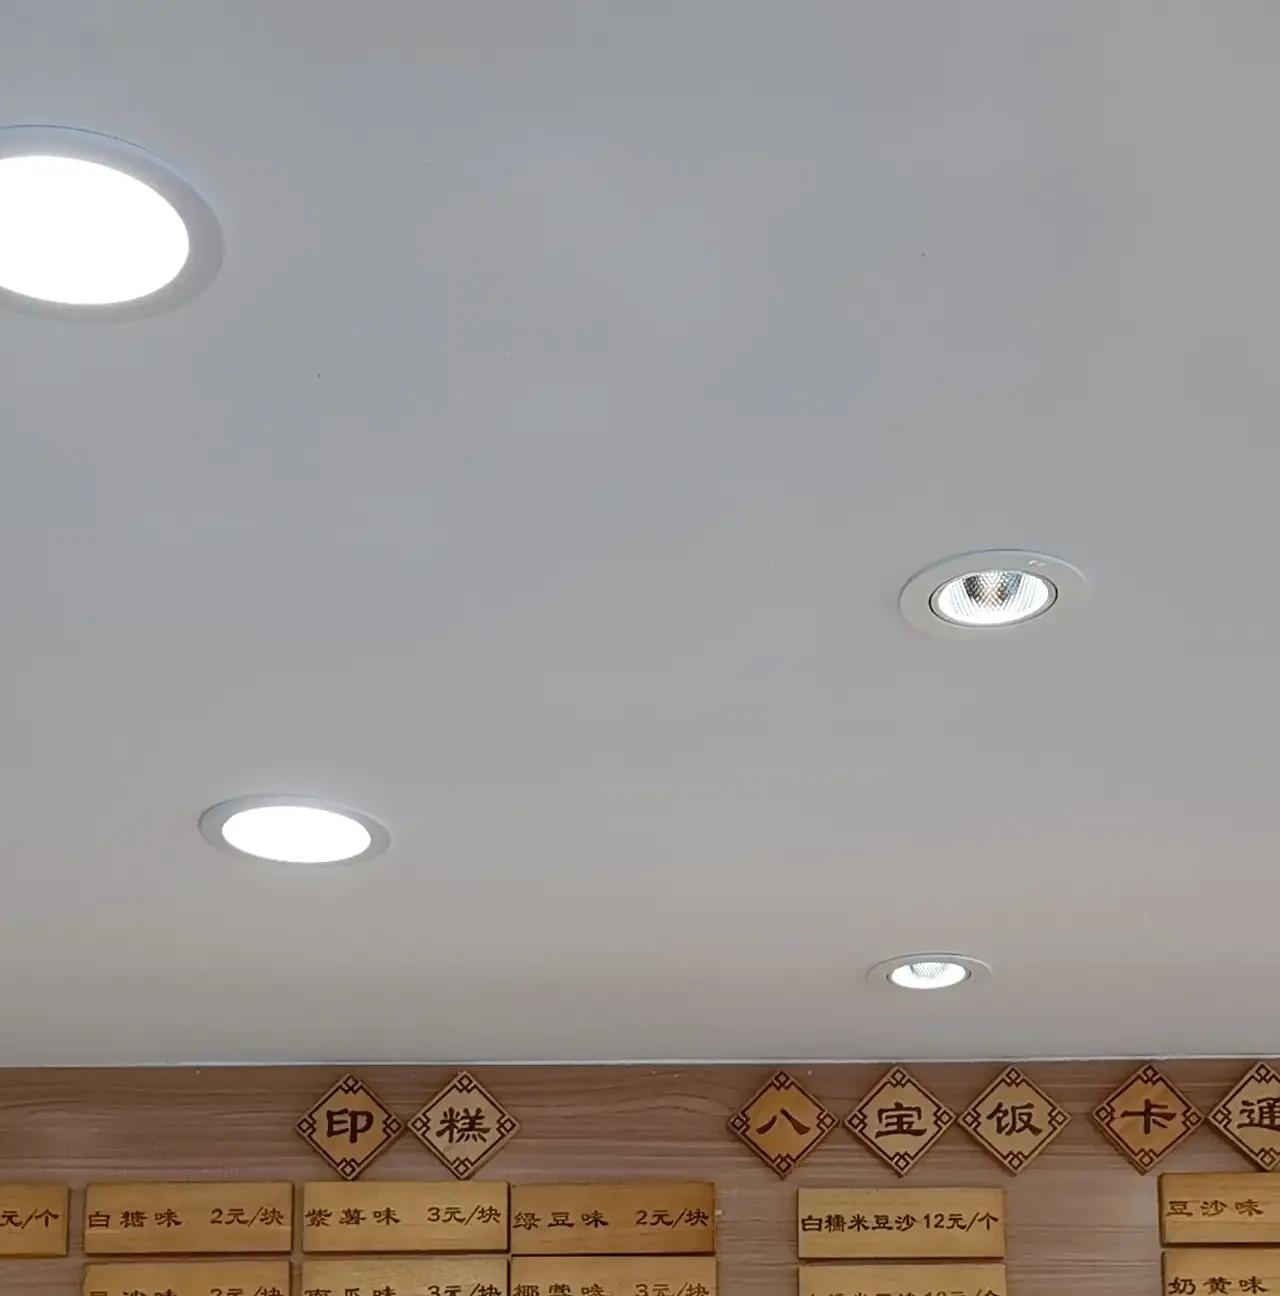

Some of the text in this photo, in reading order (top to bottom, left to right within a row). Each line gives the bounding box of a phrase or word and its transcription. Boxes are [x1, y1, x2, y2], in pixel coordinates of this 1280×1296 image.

[325, 1107, 489, 1145] 印糕
[756, 1101, 1042, 1138] 八宝饭
[88, 1207, 284, 1228] 白糖味 2元/块
[305, 1205, 501, 1227] 紫薯味 3元/块
[513, 1208, 708, 1230] 绿豆味 2元/块
[1166, 1200, 1264, 1217] 豆沙味
[801, 1212, 998, 1233] 白糯米豆沙 12元/个
[1168, 1276, 1268, 1295] 奶黄味
